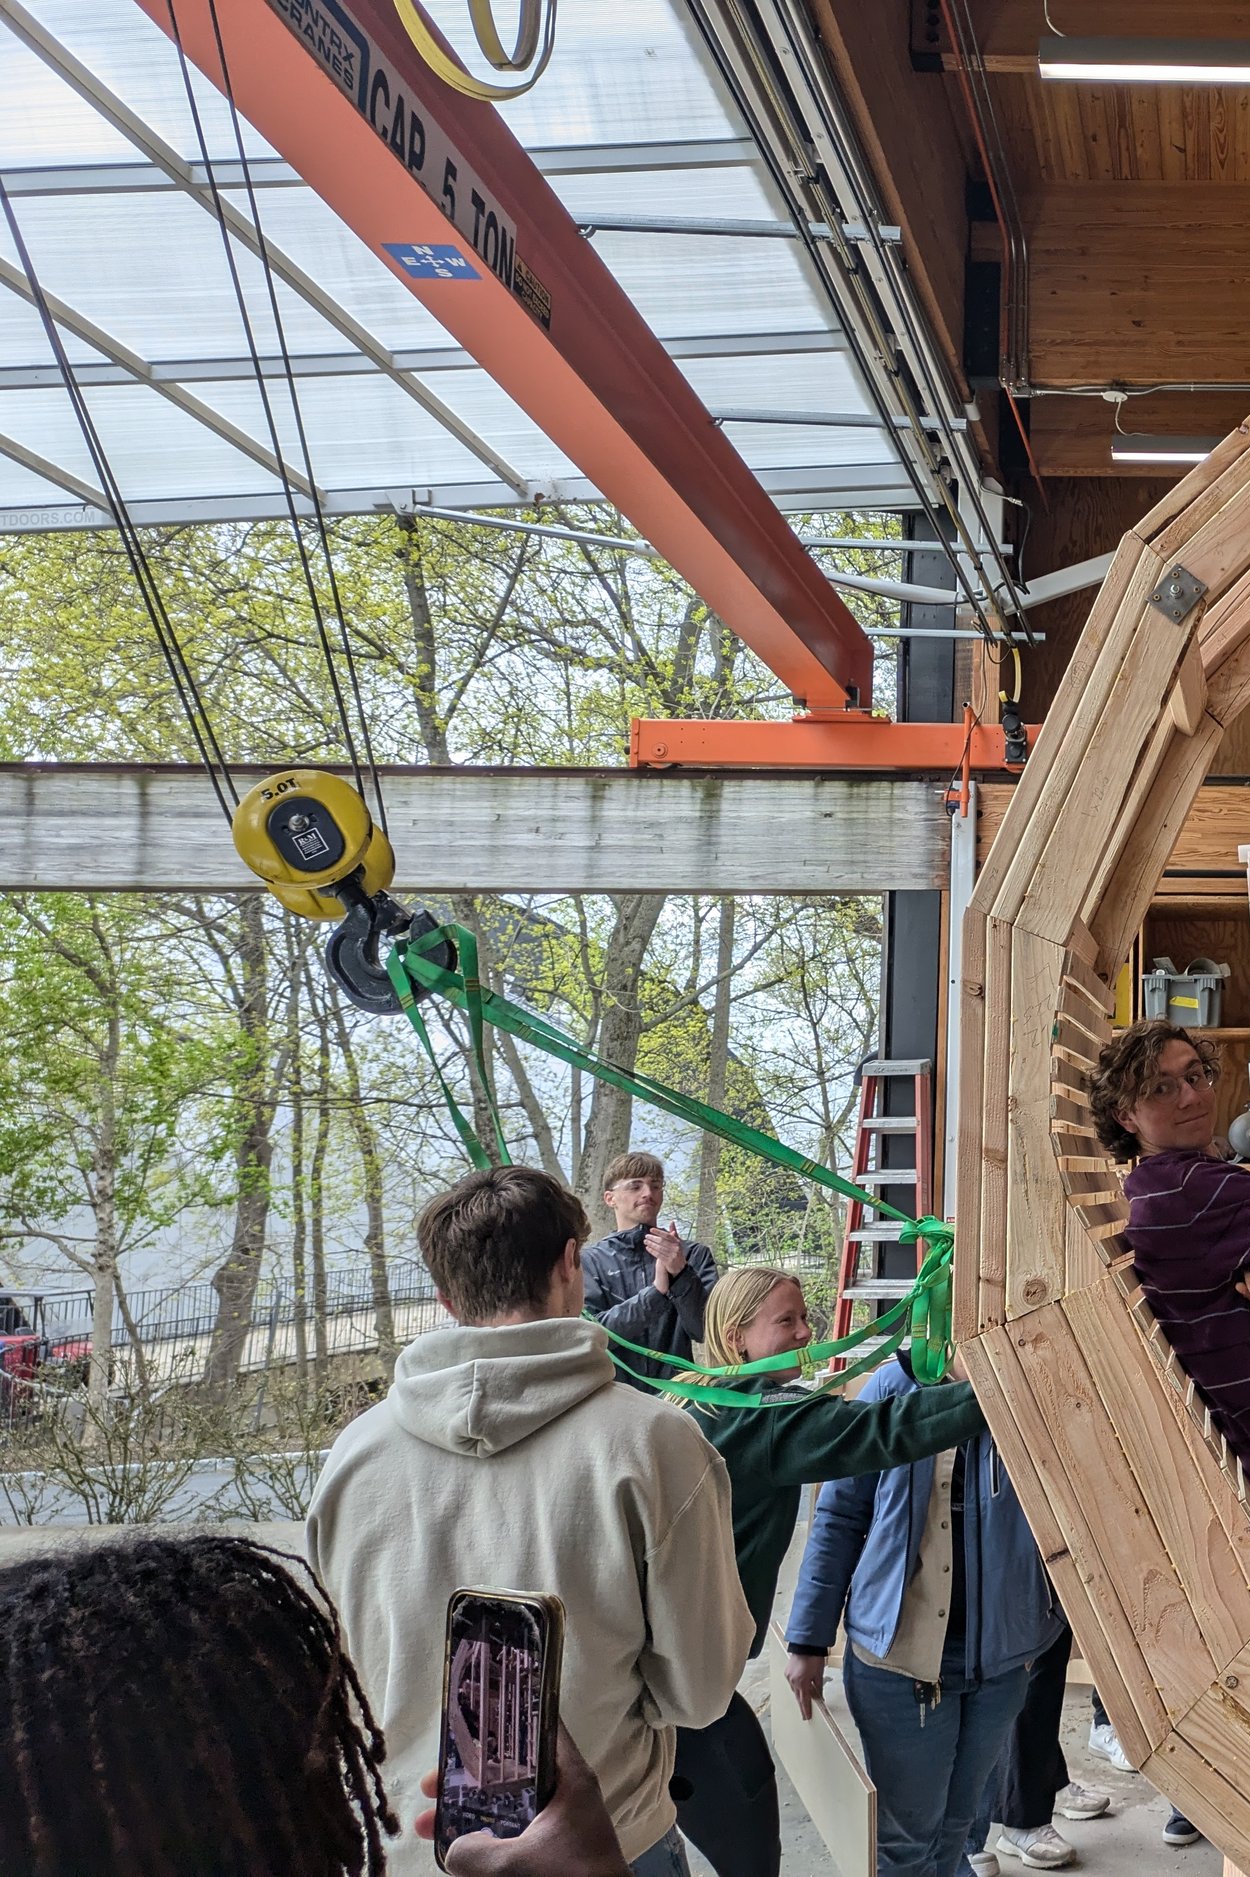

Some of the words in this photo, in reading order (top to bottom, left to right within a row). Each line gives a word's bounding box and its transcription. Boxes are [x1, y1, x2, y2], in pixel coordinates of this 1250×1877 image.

[370, 69, 426, 171] CAP
[441, 157, 458, 221] 5
[471, 188, 515, 291] TON
[411, 245, 434, 255] N
[401, 257, 421, 265] E
[445, 258, 466, 266] W
[435, 268, 453, 277] S
[261, 777, 297, 800] 5.0T
